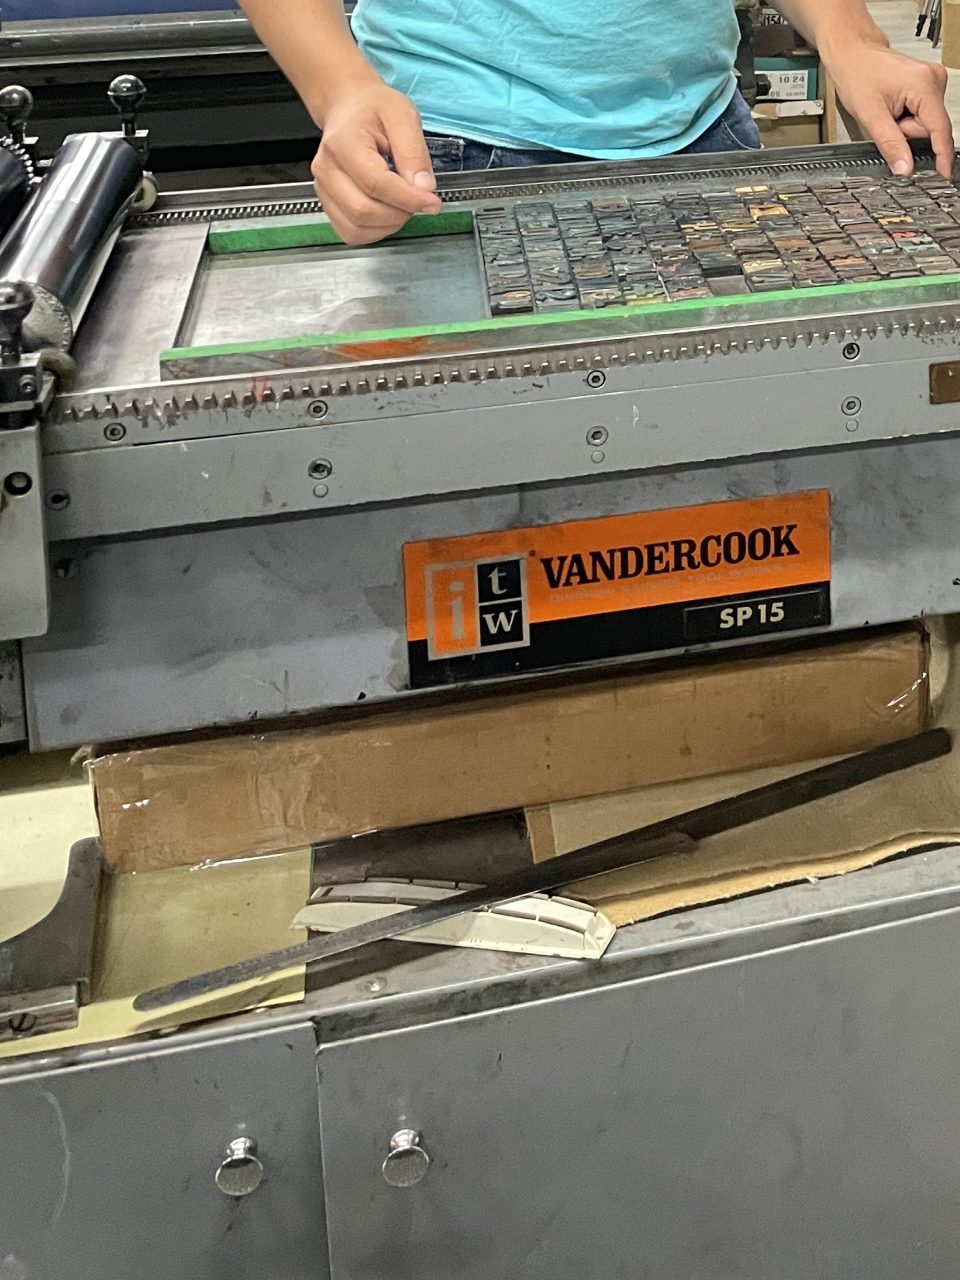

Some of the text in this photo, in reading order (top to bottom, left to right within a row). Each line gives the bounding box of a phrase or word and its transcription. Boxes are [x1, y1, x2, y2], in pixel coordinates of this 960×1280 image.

[540, 523, 800, 589] VANDERCOOK
[719, 601, 785, 629] SP 15
